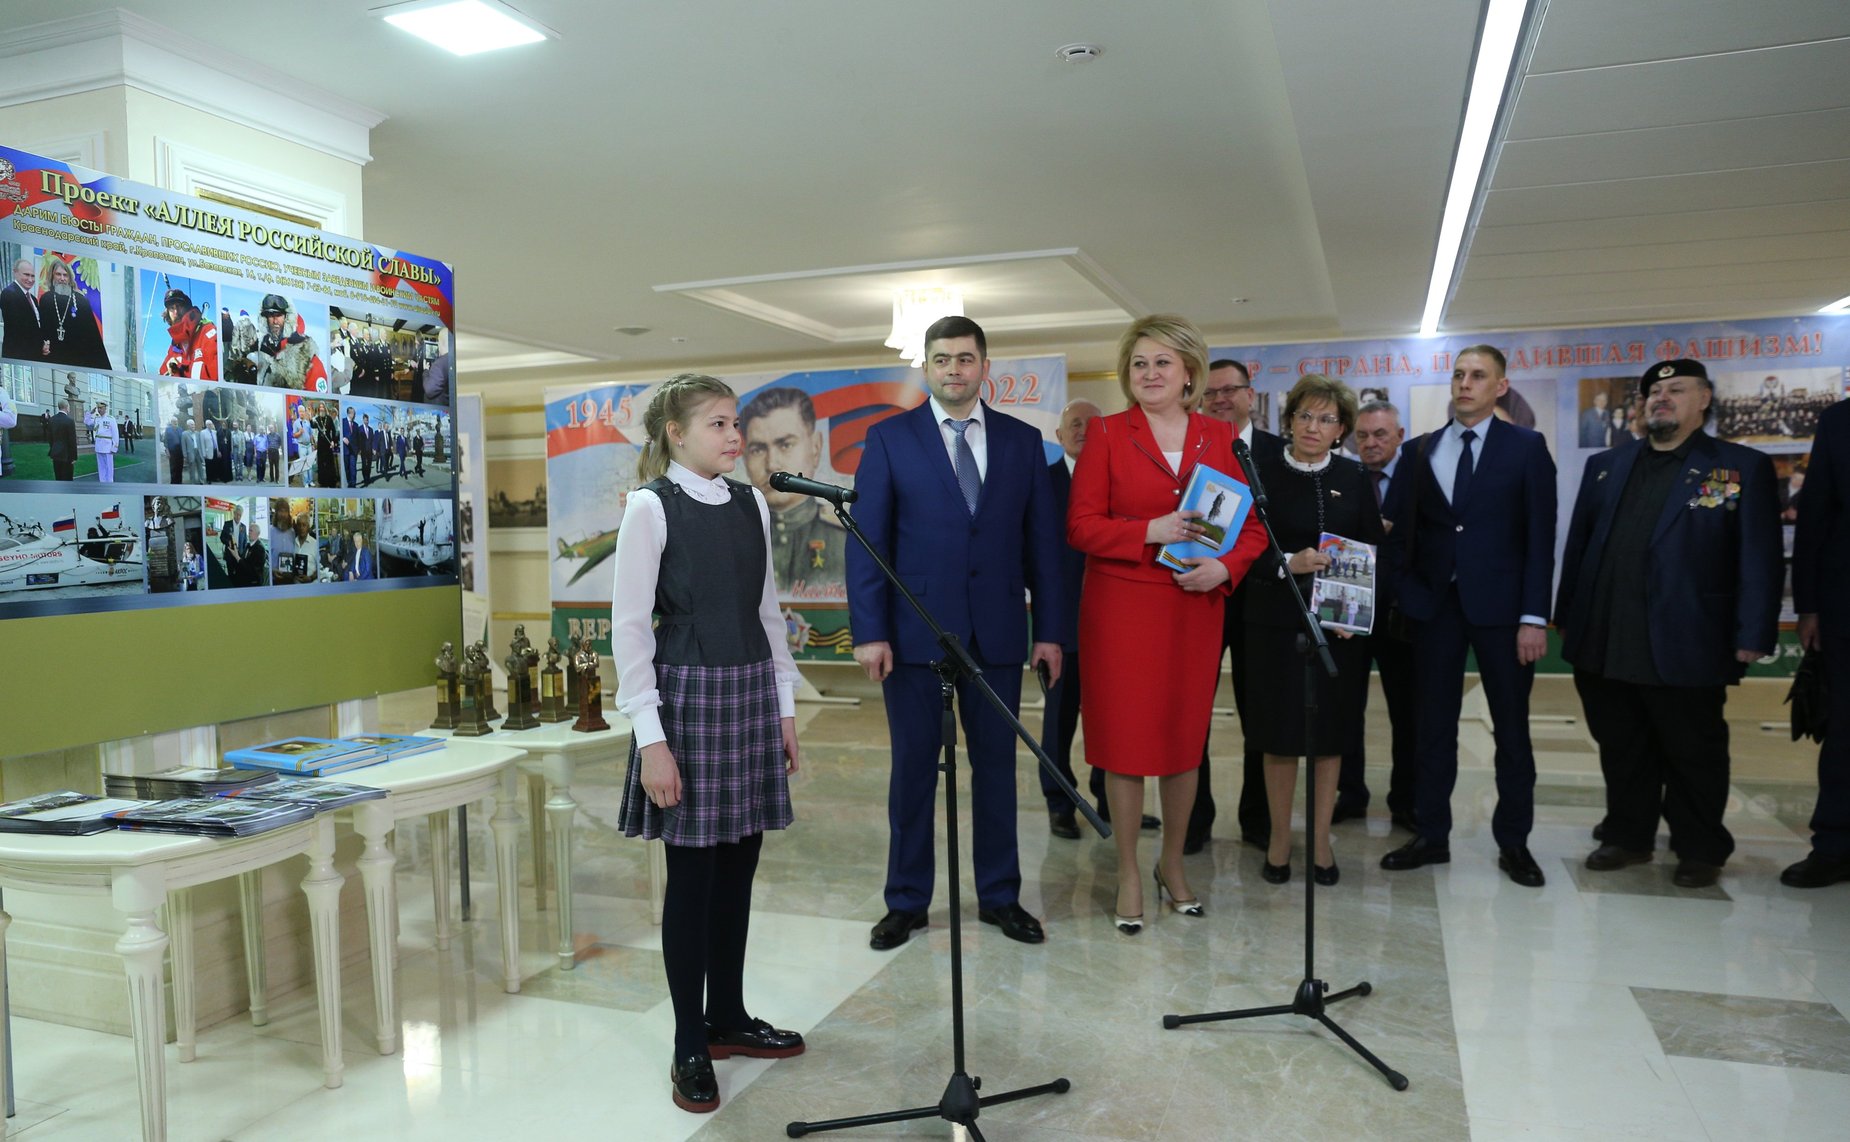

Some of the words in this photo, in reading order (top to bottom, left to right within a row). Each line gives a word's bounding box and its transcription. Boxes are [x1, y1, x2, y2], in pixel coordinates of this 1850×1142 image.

[13, 219, 99, 247] Краснодарский
[101, 240, 128, 253] край,
[13, 204, 59, 224] ДАРИМ
[61, 214, 104, 233] БЮСТЫ
[105, 224, 160, 247] ГРАЖДАН,
[161, 236, 239, 263] ПРОСЛАВИВШИХ
[241, 254, 282, 273] РОССИЮ,
[283, 264, 321, 281] УЧЕБНЫМ
[40, 169, 140, 214] Проект
[144, 201, 234, 238] «АЛЛЕЯ
[238, 221, 375, 272] РОССИЙСКОЙ
[377, 256, 442, 285] СЛАВЫ»
[1655, 332, 1822, 361] ФАШИЗМ!
[978, 372, 1041, 406] 022
[566, 397, 634, 429] 1945
